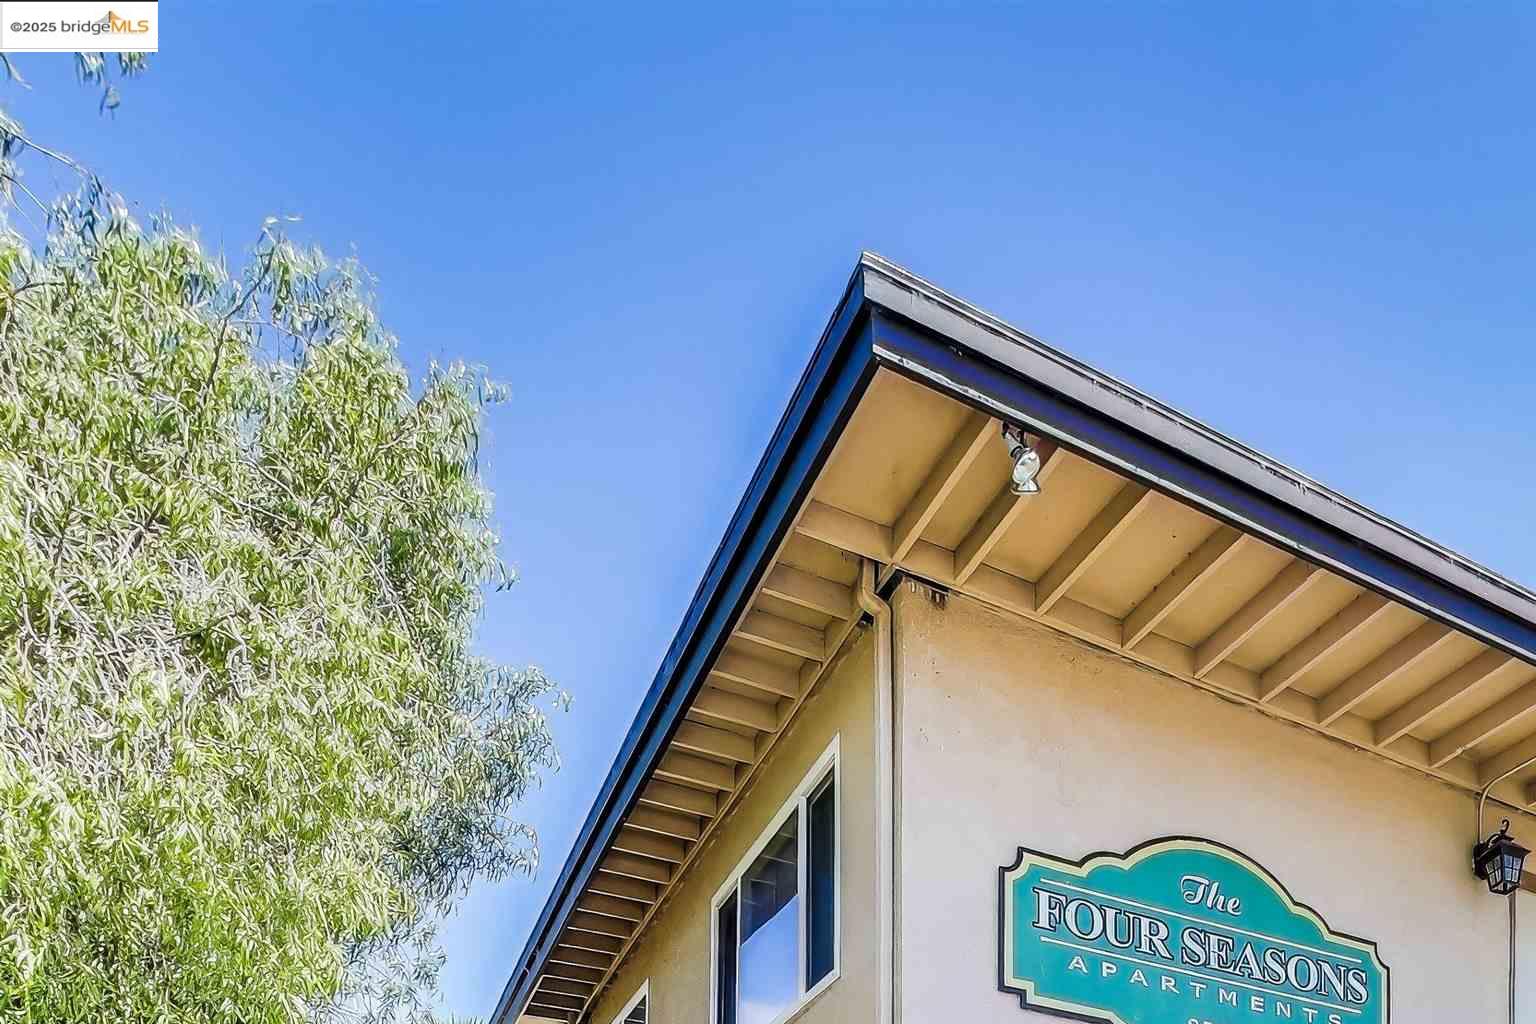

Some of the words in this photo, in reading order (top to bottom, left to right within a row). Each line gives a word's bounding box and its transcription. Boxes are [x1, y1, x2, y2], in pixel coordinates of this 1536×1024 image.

[1180, 875, 1242, 916] The
[1032, 887, 1174, 960] FOUR
[1181, 926, 1369, 1004] SEASONS
